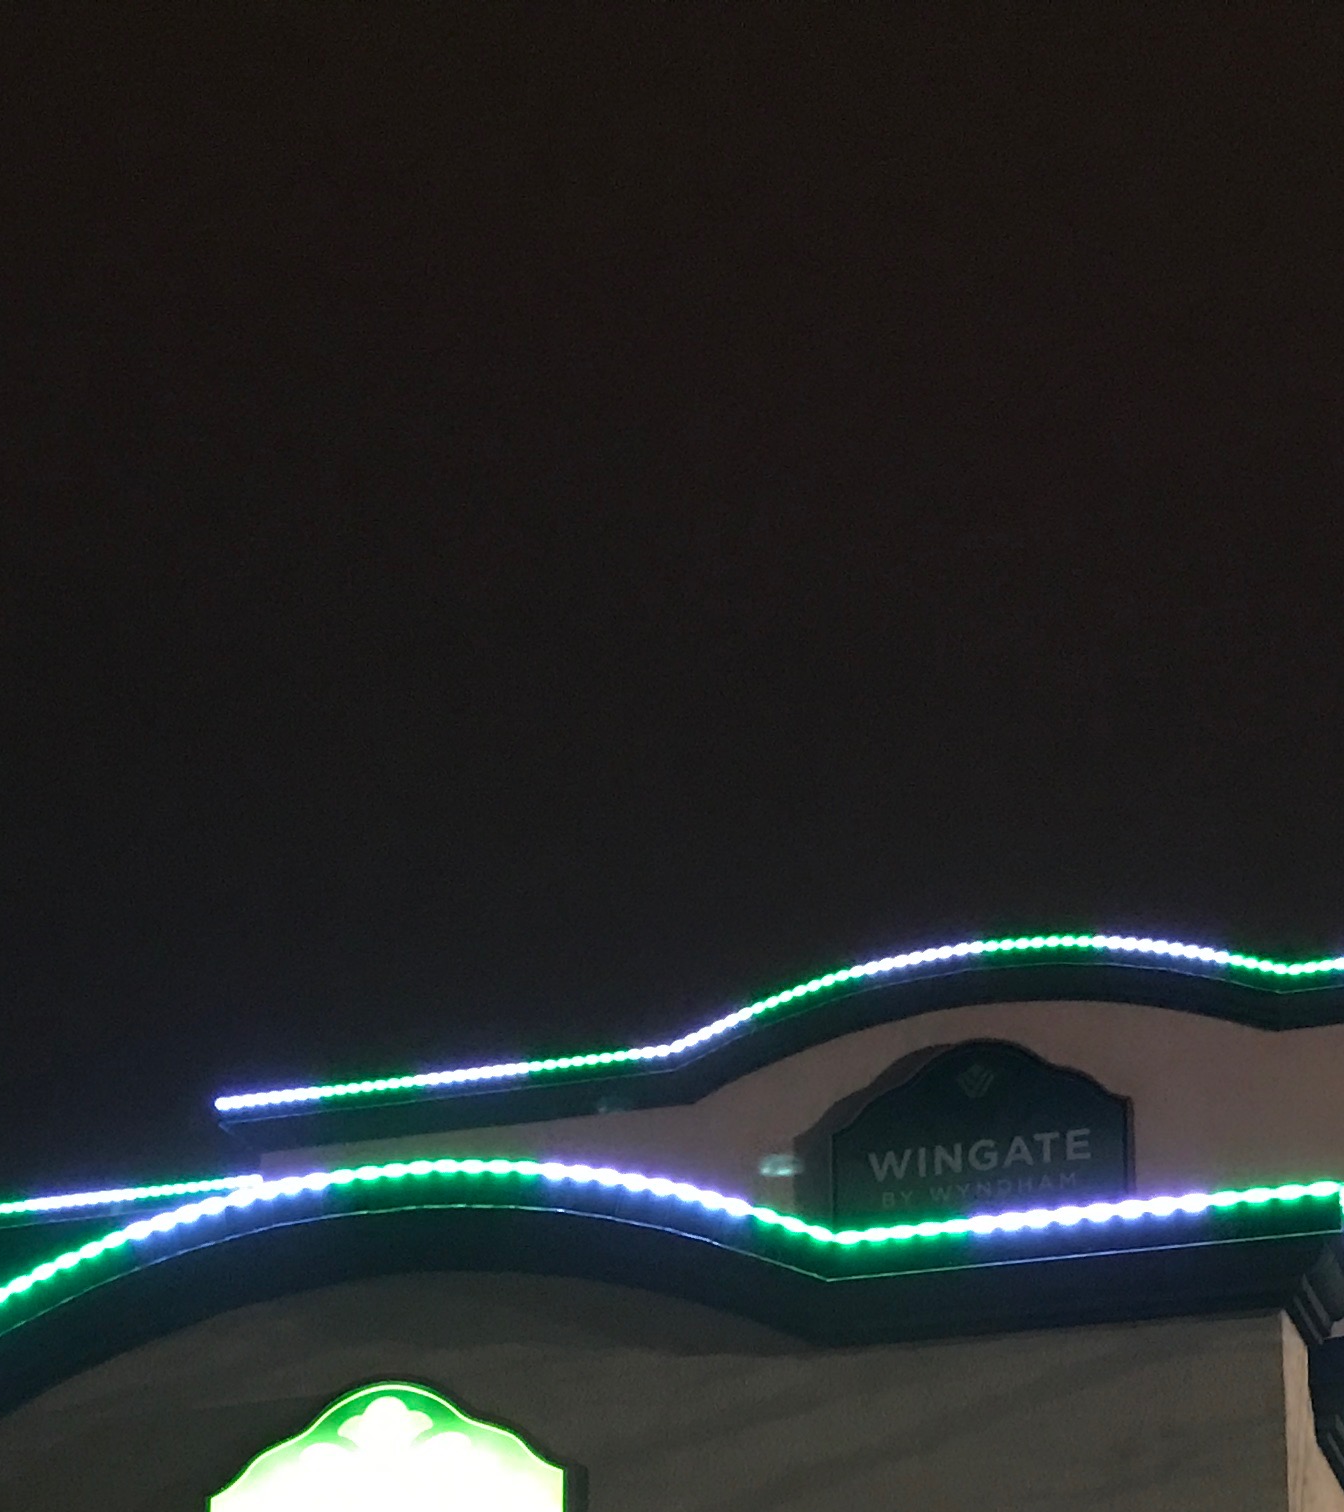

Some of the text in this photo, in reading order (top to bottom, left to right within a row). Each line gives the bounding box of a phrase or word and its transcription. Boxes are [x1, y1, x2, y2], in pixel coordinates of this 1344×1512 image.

[867, 1127, 1093, 1182] WINGATE
[881, 1172, 1077, 1208] BY WYNDHAM
